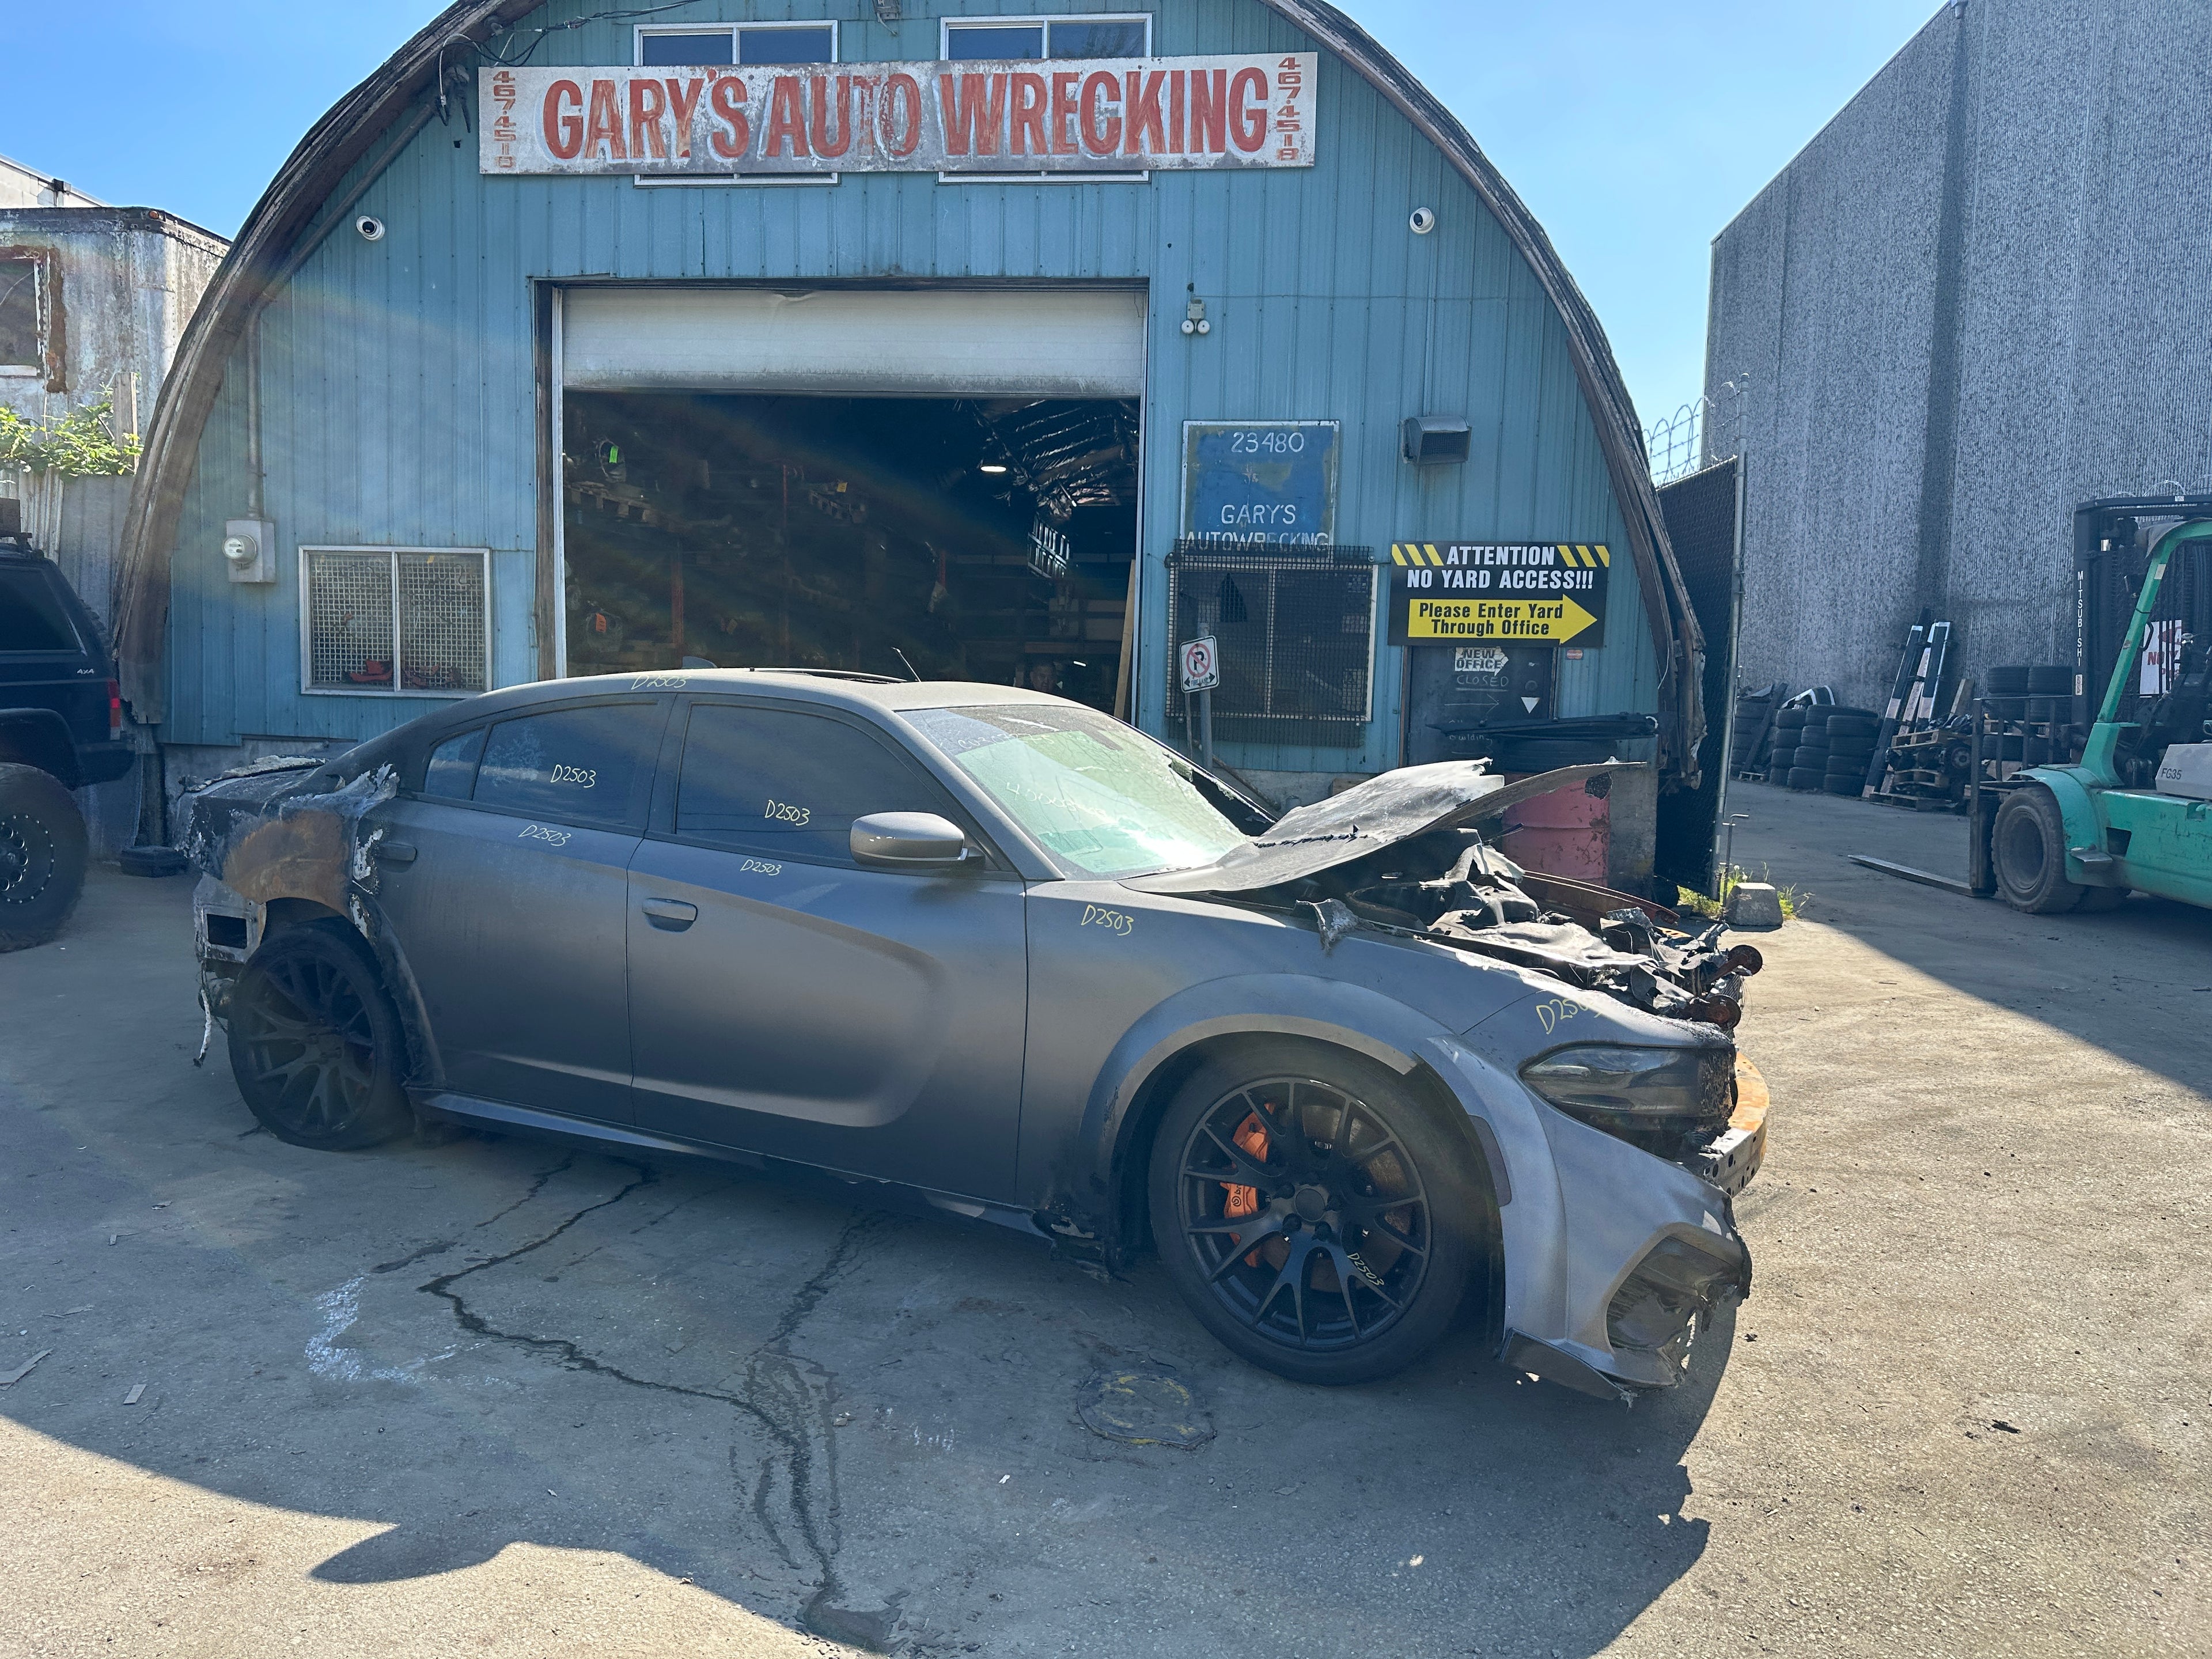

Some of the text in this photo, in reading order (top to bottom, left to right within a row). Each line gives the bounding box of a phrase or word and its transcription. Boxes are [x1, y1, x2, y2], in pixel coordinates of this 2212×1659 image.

[542, 67, 1268, 159] GARY'S AUTO WRECKING
[1231, 432, 1305, 453] 23480
[1221, 504, 1297, 524] GARY'S
[1446, 546, 1555, 566] ATTENTION
[1407, 570, 1593, 589] NO YARD ACCESS!!!
[1419, 603, 1563, 619] Please Enter Yard
[1431, 619, 1550, 637] Through Office
[1463, 649, 1495, 658] NEW
[1456, 658, 1503, 669] OFFICE
[631, 674, 692, 691] D2503
[1457, 675, 1509, 687] CLOSED
[550, 764, 597, 789] D2503
[2161, 768, 2183, 780] FG35
[764, 800, 810, 826] D2503
[518, 824, 571, 846] D2503
[740, 859, 782, 876] D2503
[1081, 904, 1134, 935] D2503
[1347, 1252, 1385, 1286] D2503
